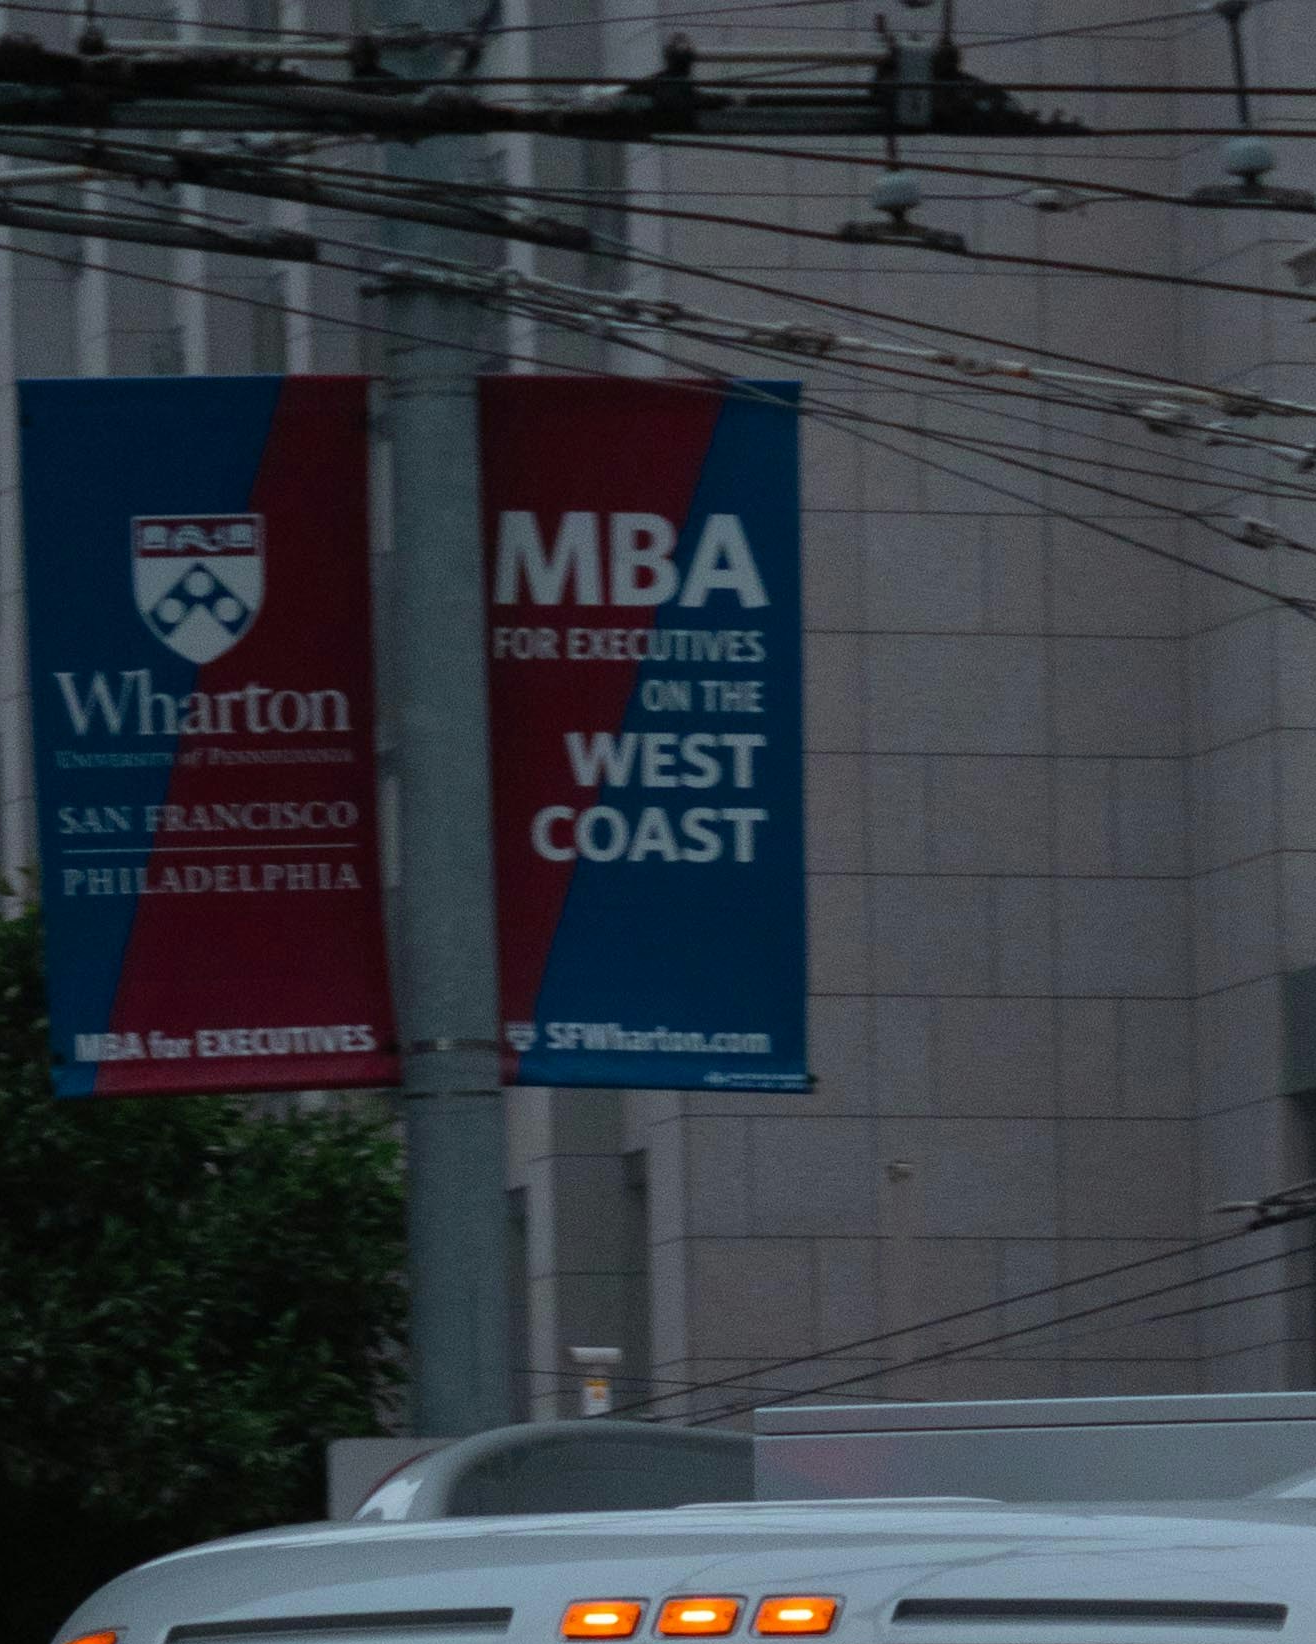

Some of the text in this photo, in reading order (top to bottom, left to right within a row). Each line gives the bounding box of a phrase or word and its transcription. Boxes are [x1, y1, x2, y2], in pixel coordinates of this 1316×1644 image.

[494, 509, 771, 608] MBA
[493, 626, 766, 663] FOR EXECUTIVES
[53, 667, 354, 736] Wharton
[641, 679, 765, 713] ON THE
[563, 731, 767, 789] WEST
[57, 800, 360, 835] SAN FRANCISCO
[530, 804, 770, 864] COAST
[61, 862, 363, 897] PHILADELPHIA
[74, 1023, 380, 1062] MBA for EXECUTIVES
